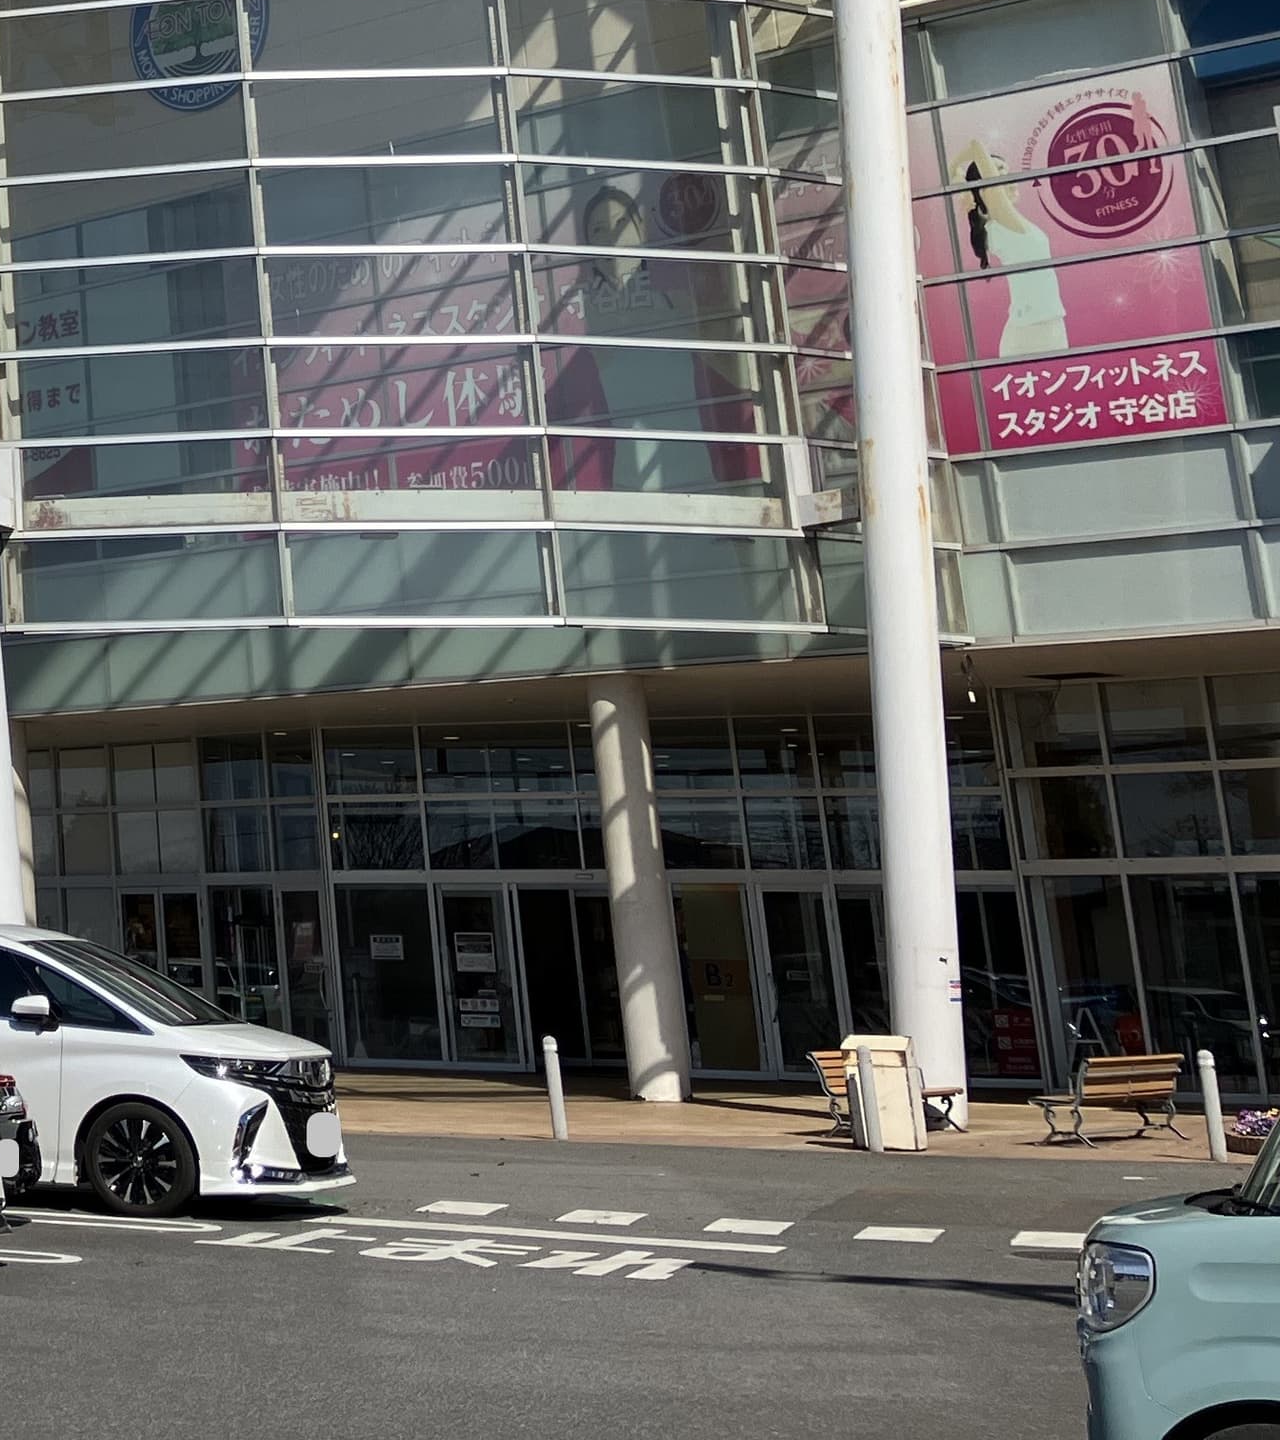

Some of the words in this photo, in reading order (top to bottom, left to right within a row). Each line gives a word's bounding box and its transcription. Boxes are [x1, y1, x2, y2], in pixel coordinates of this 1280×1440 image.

[1095, 196, 1139, 219] FITNESS
[992, 350, 1208, 401] イオンフィットネス
[998, 401, 1102, 439] スタジオ
[1109, 390, 1198, 426] 守谷店
[193, 1227, 696, 1281] 止まれ
